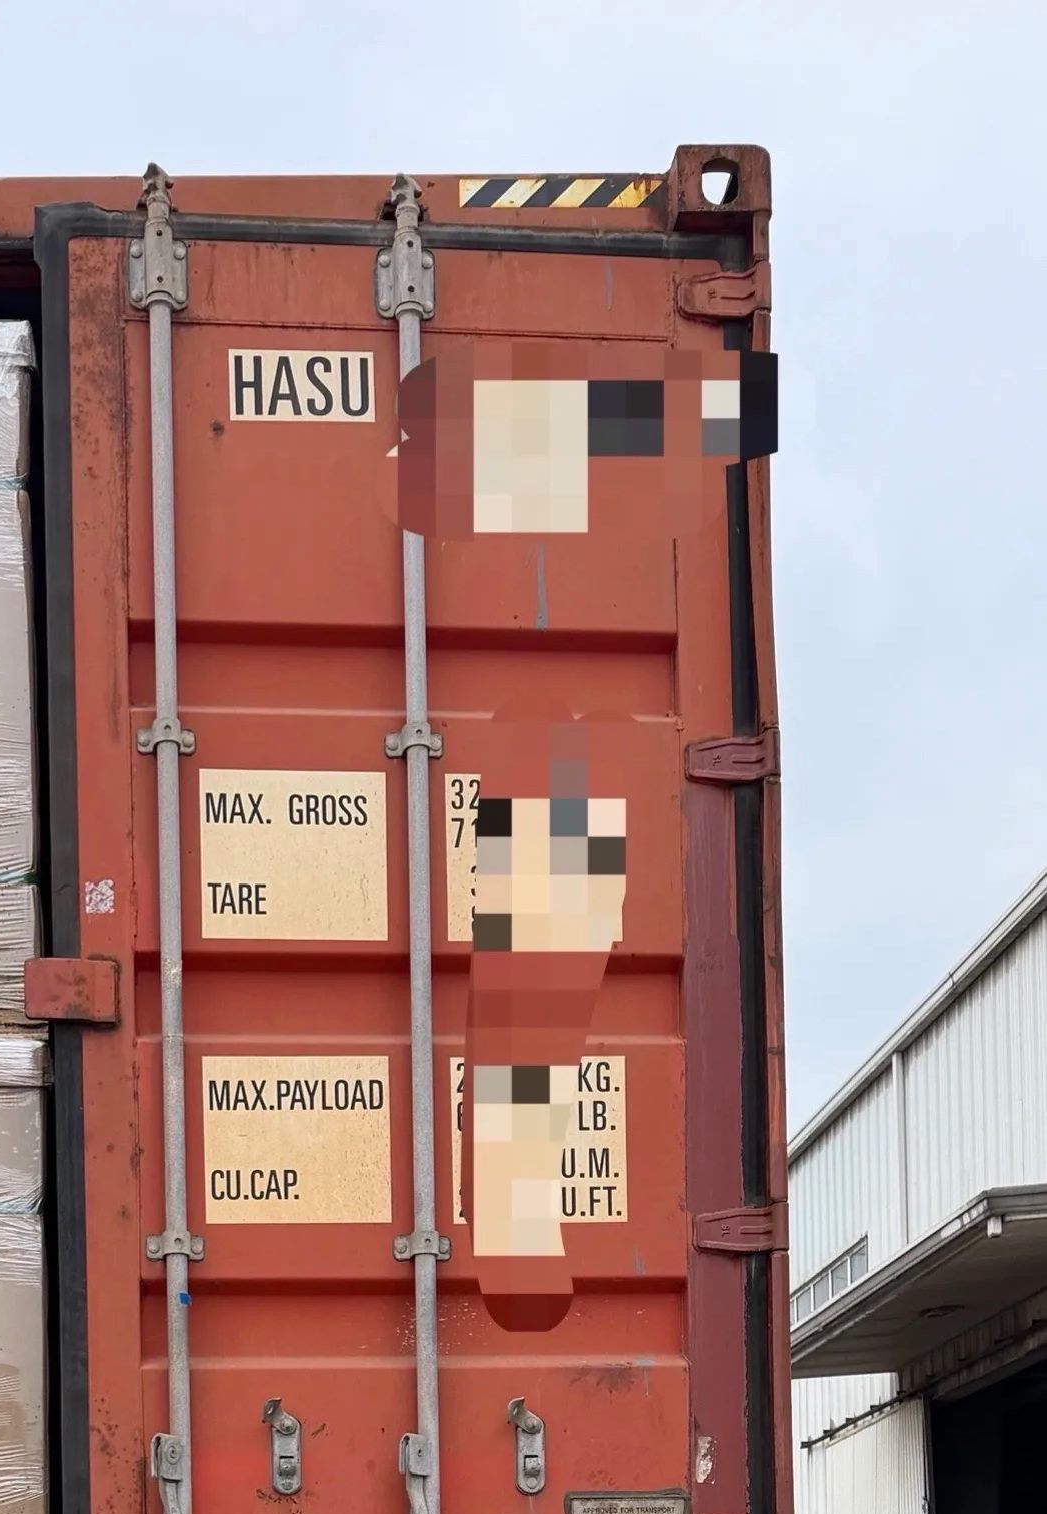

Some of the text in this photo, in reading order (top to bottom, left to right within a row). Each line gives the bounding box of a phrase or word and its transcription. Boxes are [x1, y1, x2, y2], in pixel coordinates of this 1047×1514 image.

[234, 355, 369, 416] HASU
[206, 792, 367, 826] MAX. GROSS
[208, 883, 267, 914] TARE
[578, 1062, 620, 1092] KG.
[209, 1080, 383, 1110] MAX.PAYLOAD
[578, 1100, 616, 1131] LB.
[561, 1148, 619, 1178] U.M.
[211, 1170, 300, 1200] CU.CAP.
[561, 1187, 622, 1216] U.FT.
[636, 1506, 675, 1514] TRANSPORT
